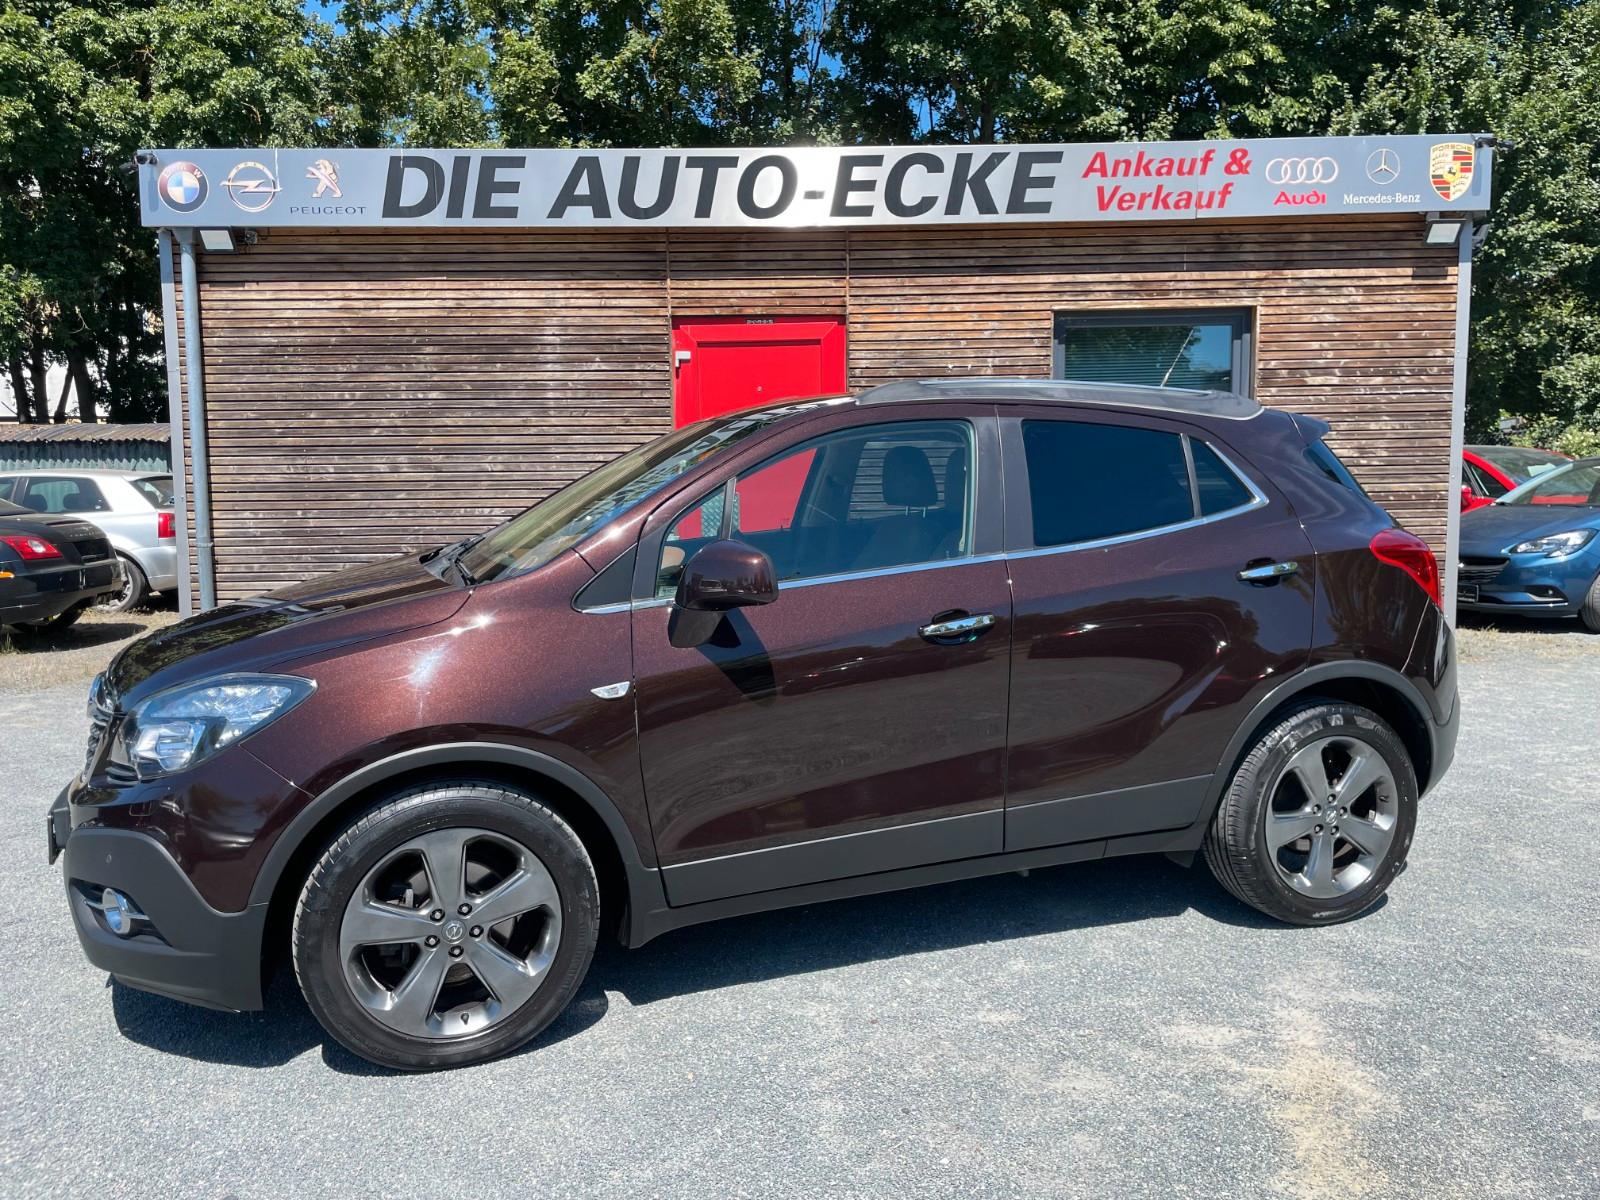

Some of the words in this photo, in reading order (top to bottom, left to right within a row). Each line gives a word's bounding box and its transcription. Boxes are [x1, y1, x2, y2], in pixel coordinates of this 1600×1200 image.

[1081, 148, 1216, 178] Ankauf
[1224, 147, 1252, 175] &
[382, 156, 526, 218] DIE
[546, 151, 1064, 220] AUTO-ECKE
[1096, 182, 1234, 211] Verkauf
[1273, 189, 1327, 205] Audi
[1343, 193, 1421, 205] Mercedes-Benz
[289, 206, 366, 215] PEUGEOT
